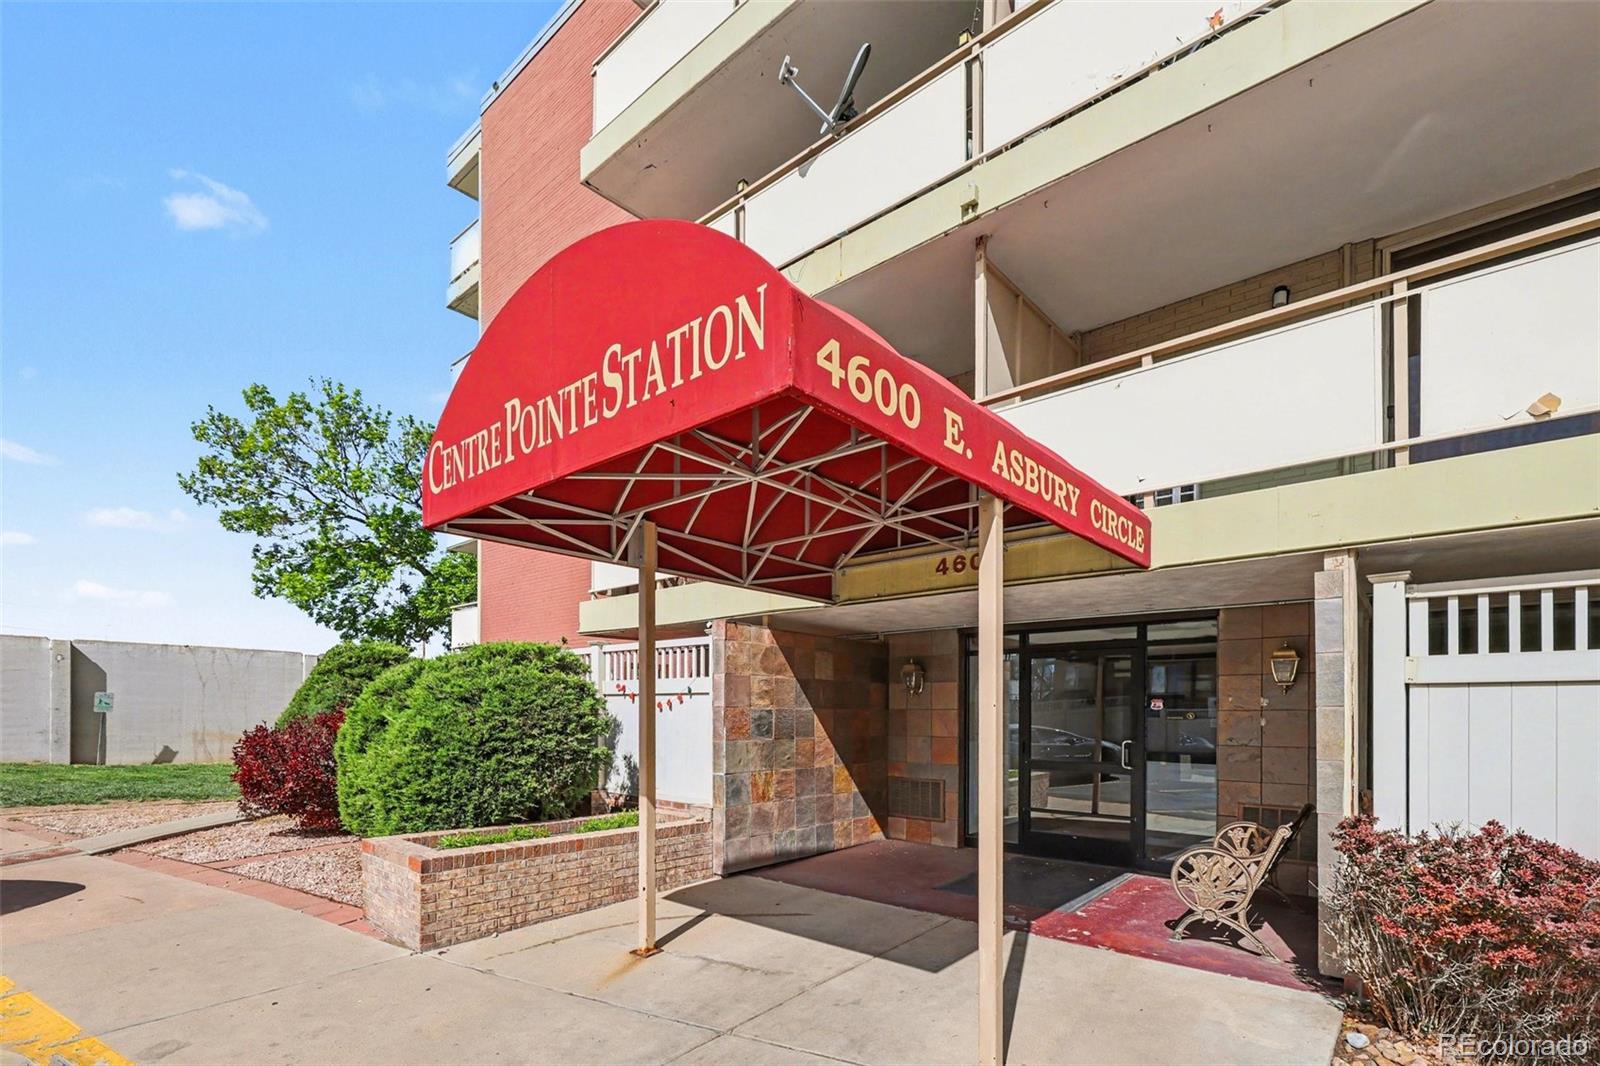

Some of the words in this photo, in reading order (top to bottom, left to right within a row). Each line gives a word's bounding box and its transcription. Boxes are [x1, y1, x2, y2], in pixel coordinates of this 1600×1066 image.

[428, 422, 502, 494] CENTRE
[504, 372, 599, 463] POINTE
[602, 283, 768, 418] STATION
[816, 338, 921, 430] 4600
[943, 407, 973, 460] E.
[991, 440, 1080, 517] ASBURY
[1090, 498, 1145, 553] CIRCLE
